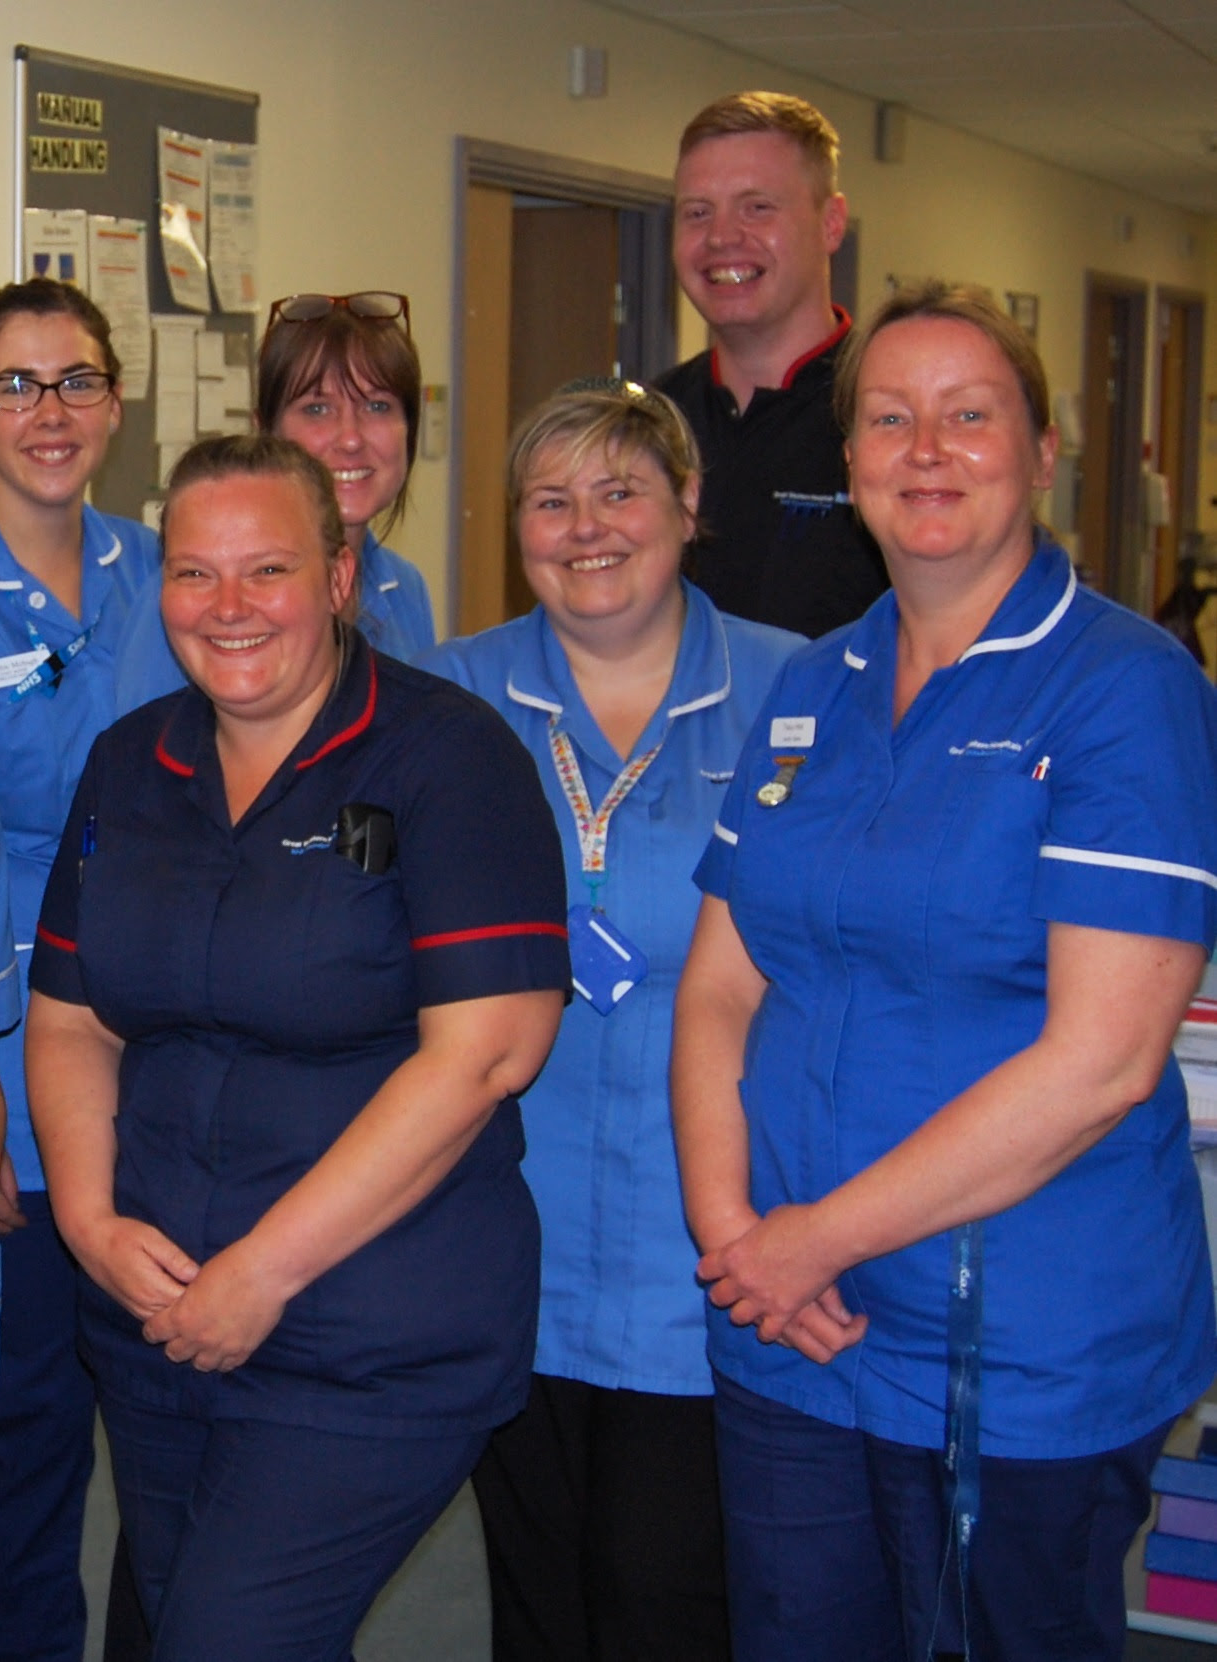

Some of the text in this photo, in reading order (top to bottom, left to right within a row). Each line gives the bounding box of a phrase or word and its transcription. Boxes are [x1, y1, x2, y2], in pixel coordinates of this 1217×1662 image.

[39, 94, 100, 128] MANUAL
[29, 138, 106, 171] HANDLING
[16, 671, 41, 695] NHS
